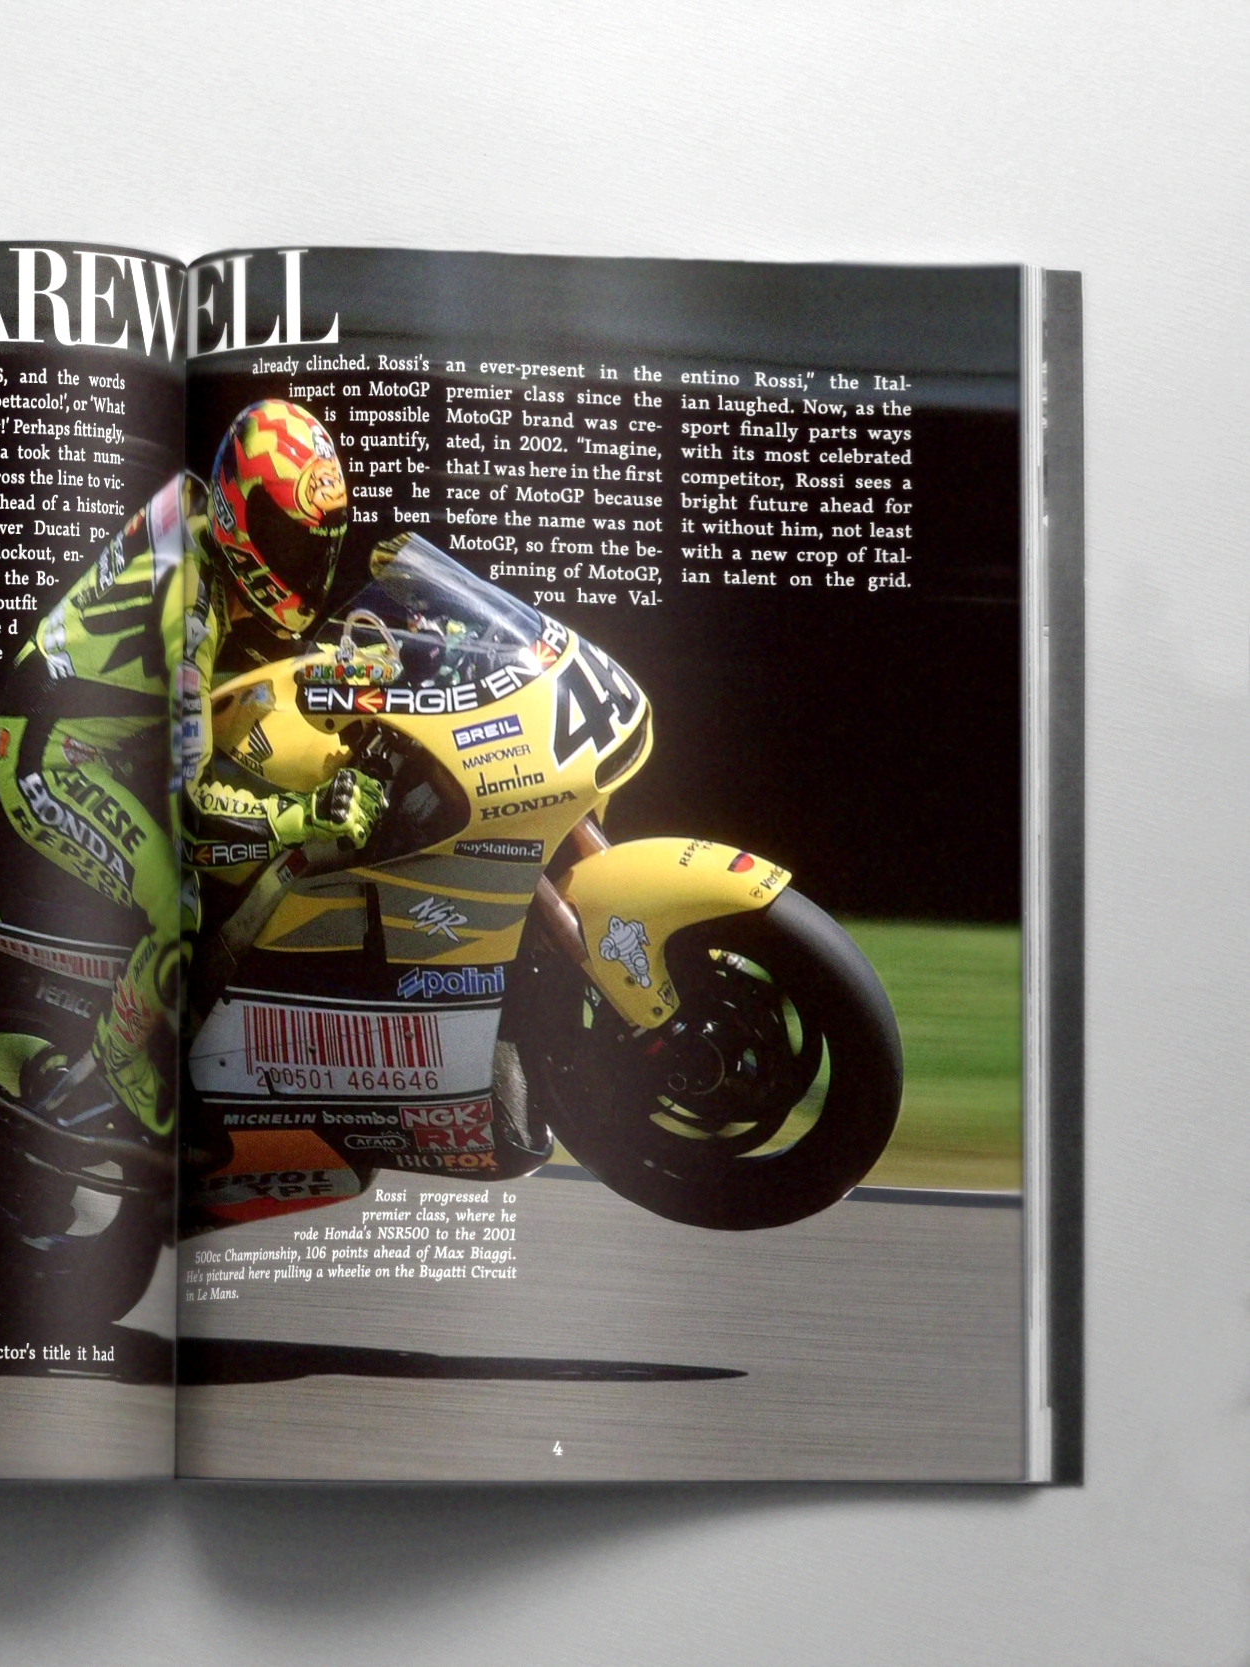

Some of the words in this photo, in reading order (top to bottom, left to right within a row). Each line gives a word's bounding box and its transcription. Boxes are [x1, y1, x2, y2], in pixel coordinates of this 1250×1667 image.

[252, 355, 300, 377] already
[305, 353, 371, 371] clinched.
[377, 353, 430, 372] Rossi's
[19, 367, 48, 385] and
[57, 368, 80, 386] the
[88, 373, 126, 390] words
[681, 369, 740, 386] entino
[829, 373, 859, 390] the
[873, 375, 912, 391] Ital-
[288, 382, 336, 402] impact
[342, 385, 362, 397] on
[368, 380, 431, 398] MotoGP
[445, 432, 485, 453] ated,
[493, 434, 512, 451] in
[519, 435, 568, 453] 2002.
[681, 471, 785, 491] competitor,
[795, 472, 845, 489] Rossi
[855, 477, 892, 490] sees
[902, 478, 913, 490] a
[224, 545, 291, 608] 46
[681, 567, 711, 584] ian
[723, 568, 777, 586] talent
[789, 575, 813, 587] on
[825, 570, 855, 587] the
[867, 571, 912, 593] grid.
[304, 664, 334, 681] THE
[334, 663, 394, 681] DOCTOR
[456, 720, 520, 747] BREIL
[230, 746, 266, 778] HONDA
[462, 743, 531, 770] MANPOWER
[476, 765, 545, 798] domino
[192, 784, 269, 817] HONDA
[480, 790, 578, 821] HONDA
[18, 772, 129, 889] HONDA
[408, 896, 469, 943] NSR
[422, 966, 505, 998] polini
[255, 1067, 334, 1090] 200501
[348, 1071, 439, 1090] 464646
[223, 1112, 317, 1126] MICHELIN
[323, 1110, 399, 1126] brembo
[404, 1106, 477, 1128] NGK
[356, 1136, 397, 1148] AFAM
[416, 1126, 488, 1149] RK
[374, 1188, 407, 1203] Rossi
[419, 1189, 489, 1207] progressed
[502, 1191, 517, 1204] to
[361, 1207, 412, 1225] premier
[415, 1207, 450, 1224] class,
[455, 1207, 496, 1222] where
[501, 1208, 517, 1223] he
[293, 1226, 319, 1241] rode
[323, 1224, 372, 1241] Honda's
[377, 1226, 430, 1240] NSR500
[435, 1227, 449, 1241] to
[455, 1226, 477, 1241] the
[482, 1227, 516, 1241] 2001
[195, 1249, 222, 1264] 500cc
[225, 1247, 301, 1265] Championship,
[305, 1245, 327, 1260] 106
[332, 1246, 369, 1263] points
[373, 1244, 411, 1259] ahead
[415, 1244, 432, 1263] of
[433, 1245, 465, 1259] Max
[469, 1246, 517, 1264] Biaggi.
[186, 1269, 204, 1283] He's
[206, 1266, 245, 1285] pictured
[248, 1265, 271, 1280] here
[273, 1264, 313, 1283] pulling
[315, 1268, 324, 1279] a
[327, 1263, 372, 1278] wheelie
[375, 1267, 391, 1278] on
[394, 1263, 415, 1278] the
[418, 1264, 467, 1282] Bugatti
[470, 1265, 517, 1279] Circuit
[186, 1291, 195, 1302] in
[196, 1288, 208, 1301] Le
[209, 1287, 239, 1300] Mans.
[42, 1343, 71, 1361] title
[77, 1345, 87, 1361] it
[92, 1345, 115, 1362] had
[553, 1441, 563, 1455] 4
